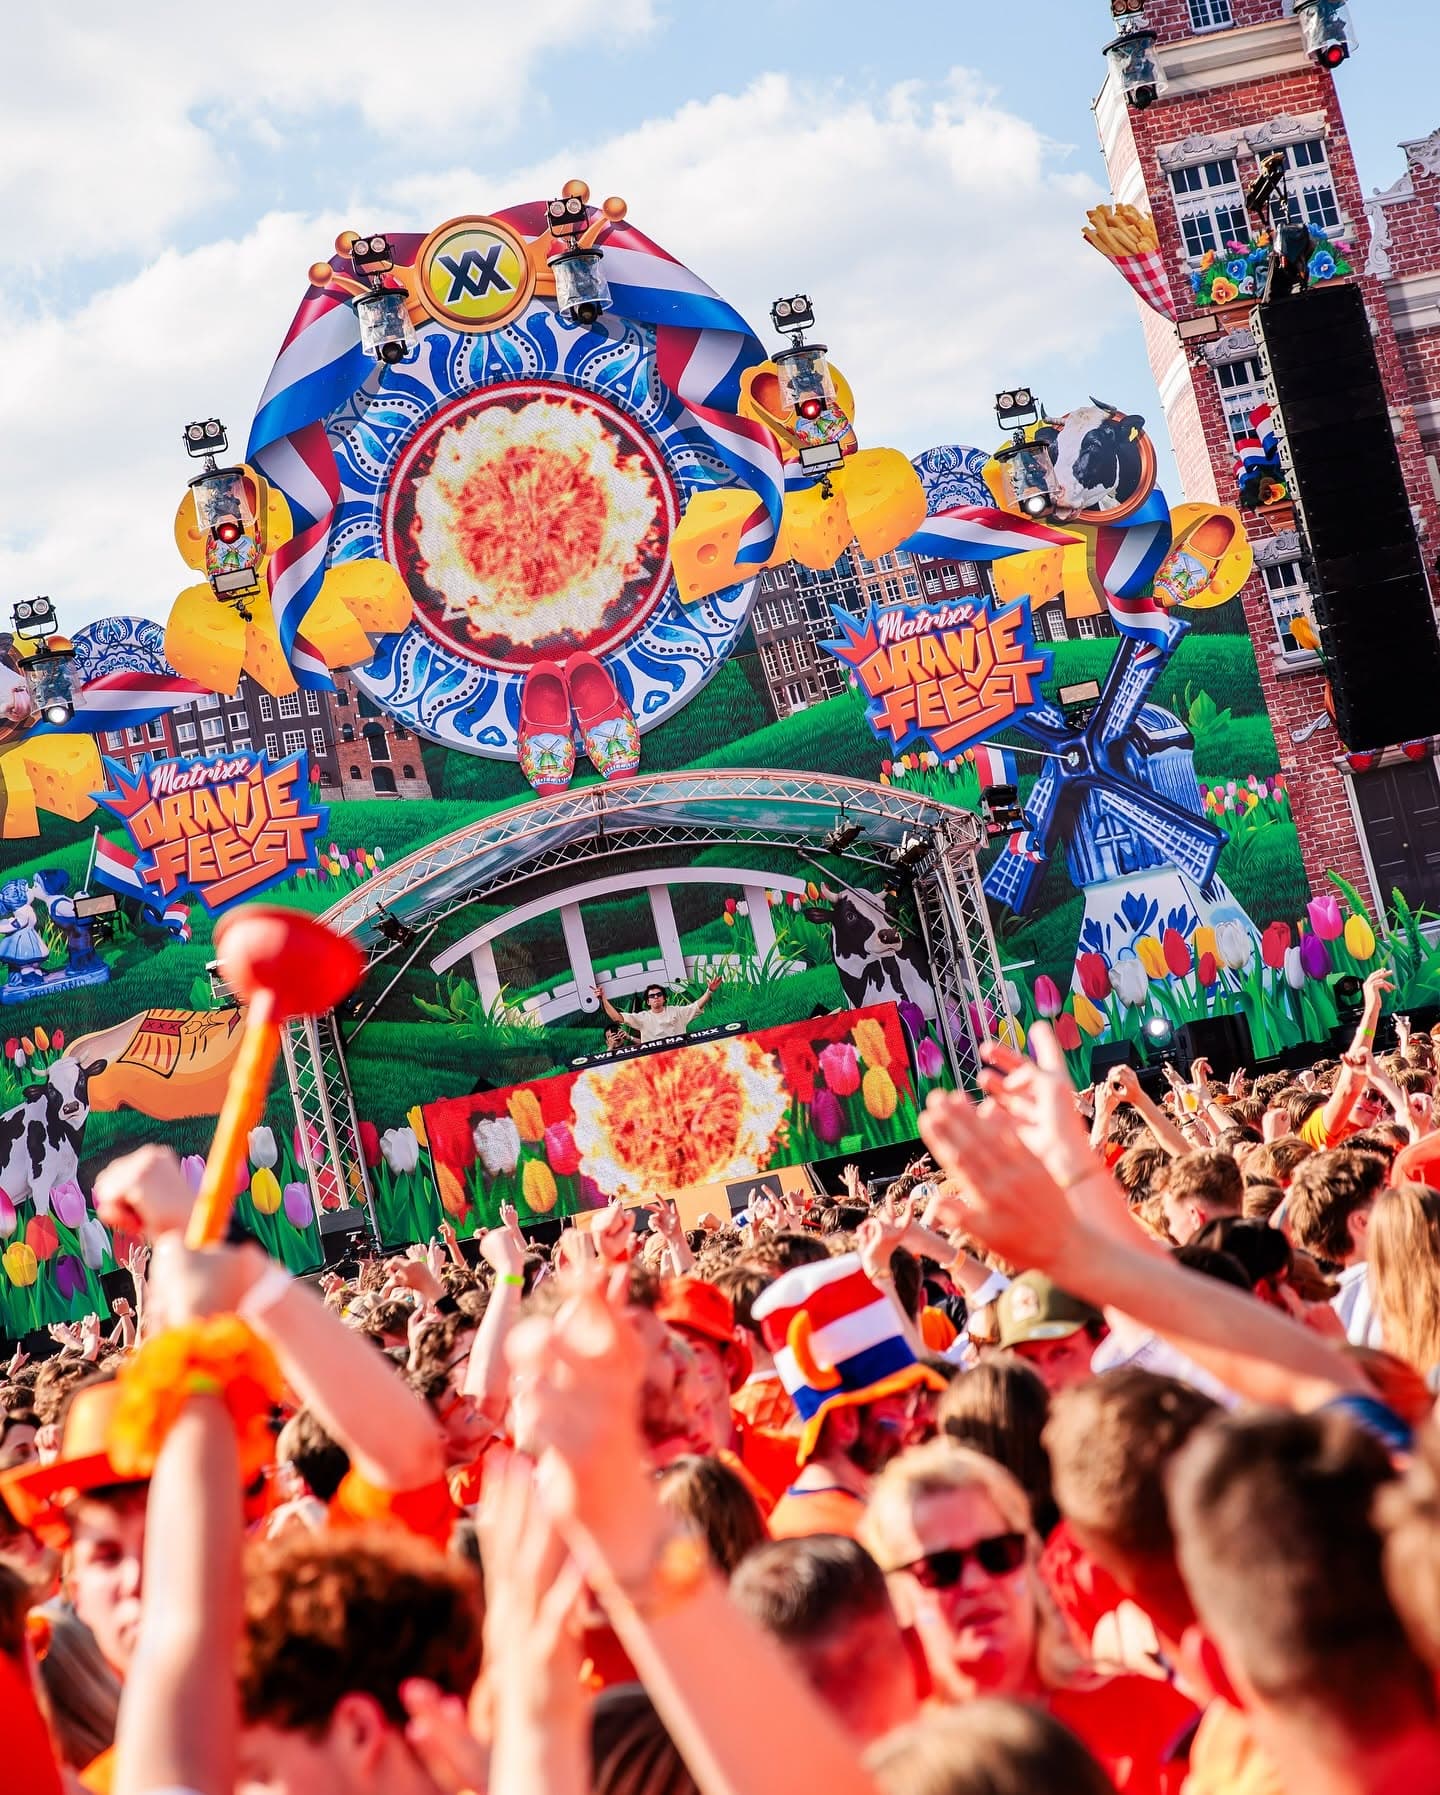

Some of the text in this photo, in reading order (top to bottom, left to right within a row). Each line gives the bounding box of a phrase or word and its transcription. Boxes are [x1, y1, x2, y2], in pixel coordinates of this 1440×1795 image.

[857, 606, 1024, 697] ORANJE
[878, 604, 974, 645] Matrixx
[872, 660, 1045, 752] FEEST
[128, 761, 299, 850] ORANJE
[151, 758, 250, 798] Matrixx
[142, 816, 319, 908] FEEST
[594, 1052, 613, 1060] WE
[616, 1047, 637, 1055] ALL
[640, 1041, 663, 1050] ARE
